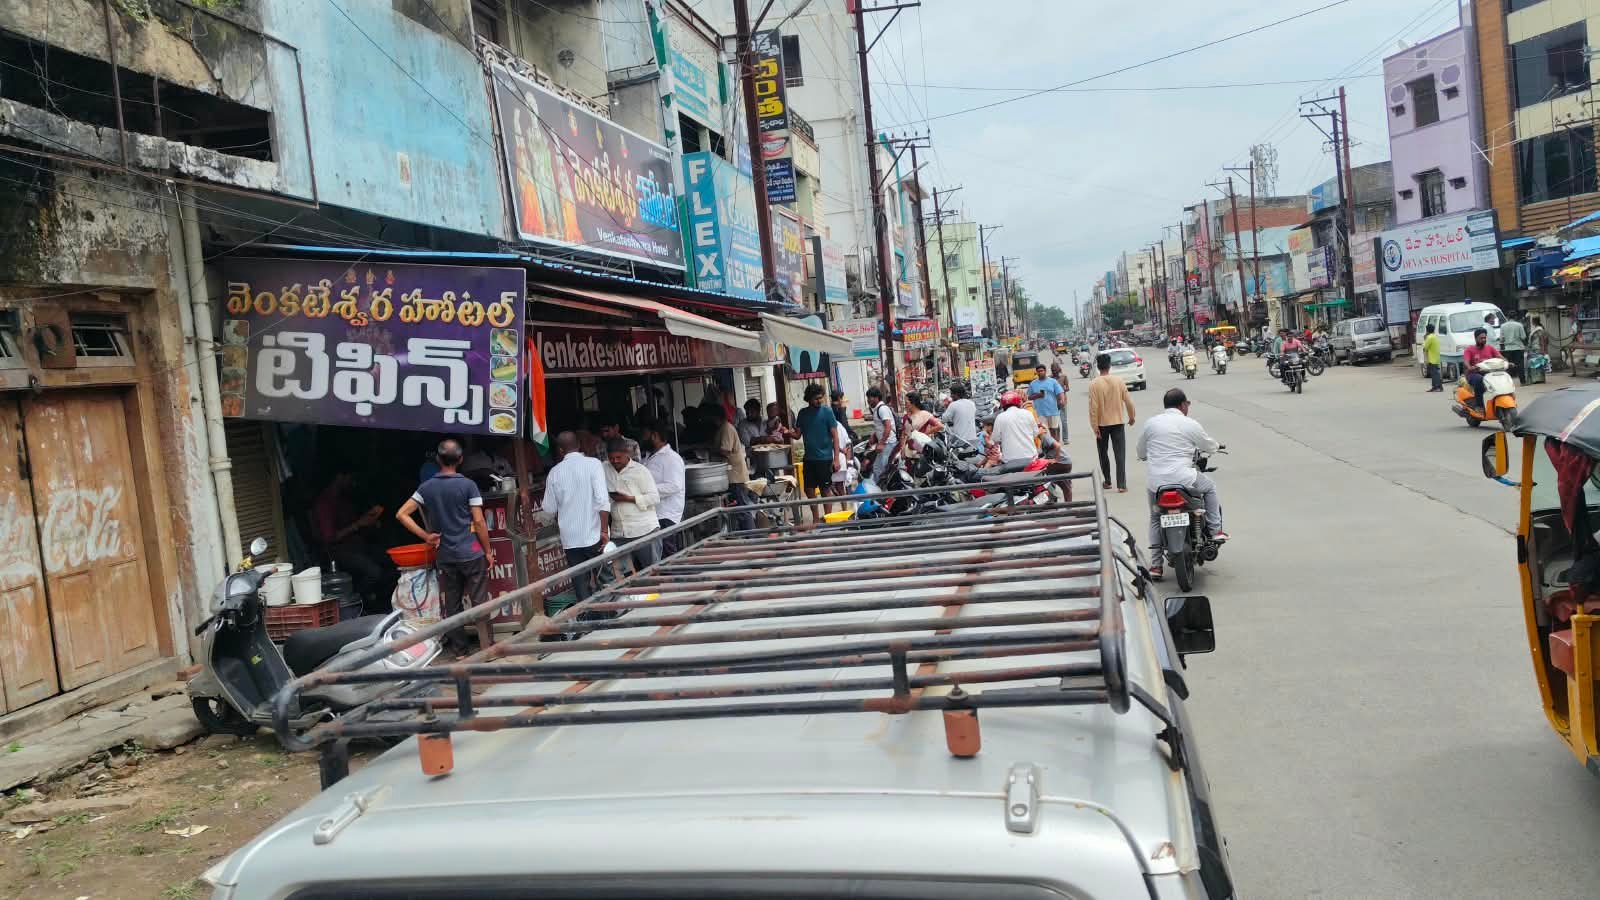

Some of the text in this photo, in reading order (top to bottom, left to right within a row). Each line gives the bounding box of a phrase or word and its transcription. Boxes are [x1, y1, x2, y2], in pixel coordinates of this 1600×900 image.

[688, 160, 721, 277] FLEX
[652, 241, 669, 257] Hotel
[1431, 250, 1472, 265] HOSPITAL
[227, 278, 518, 328] వెంకటేశ్వర హోటల్
[659, 336, 691, 363] Hotel
[255, 331, 484, 426] టిఫిన్స్
